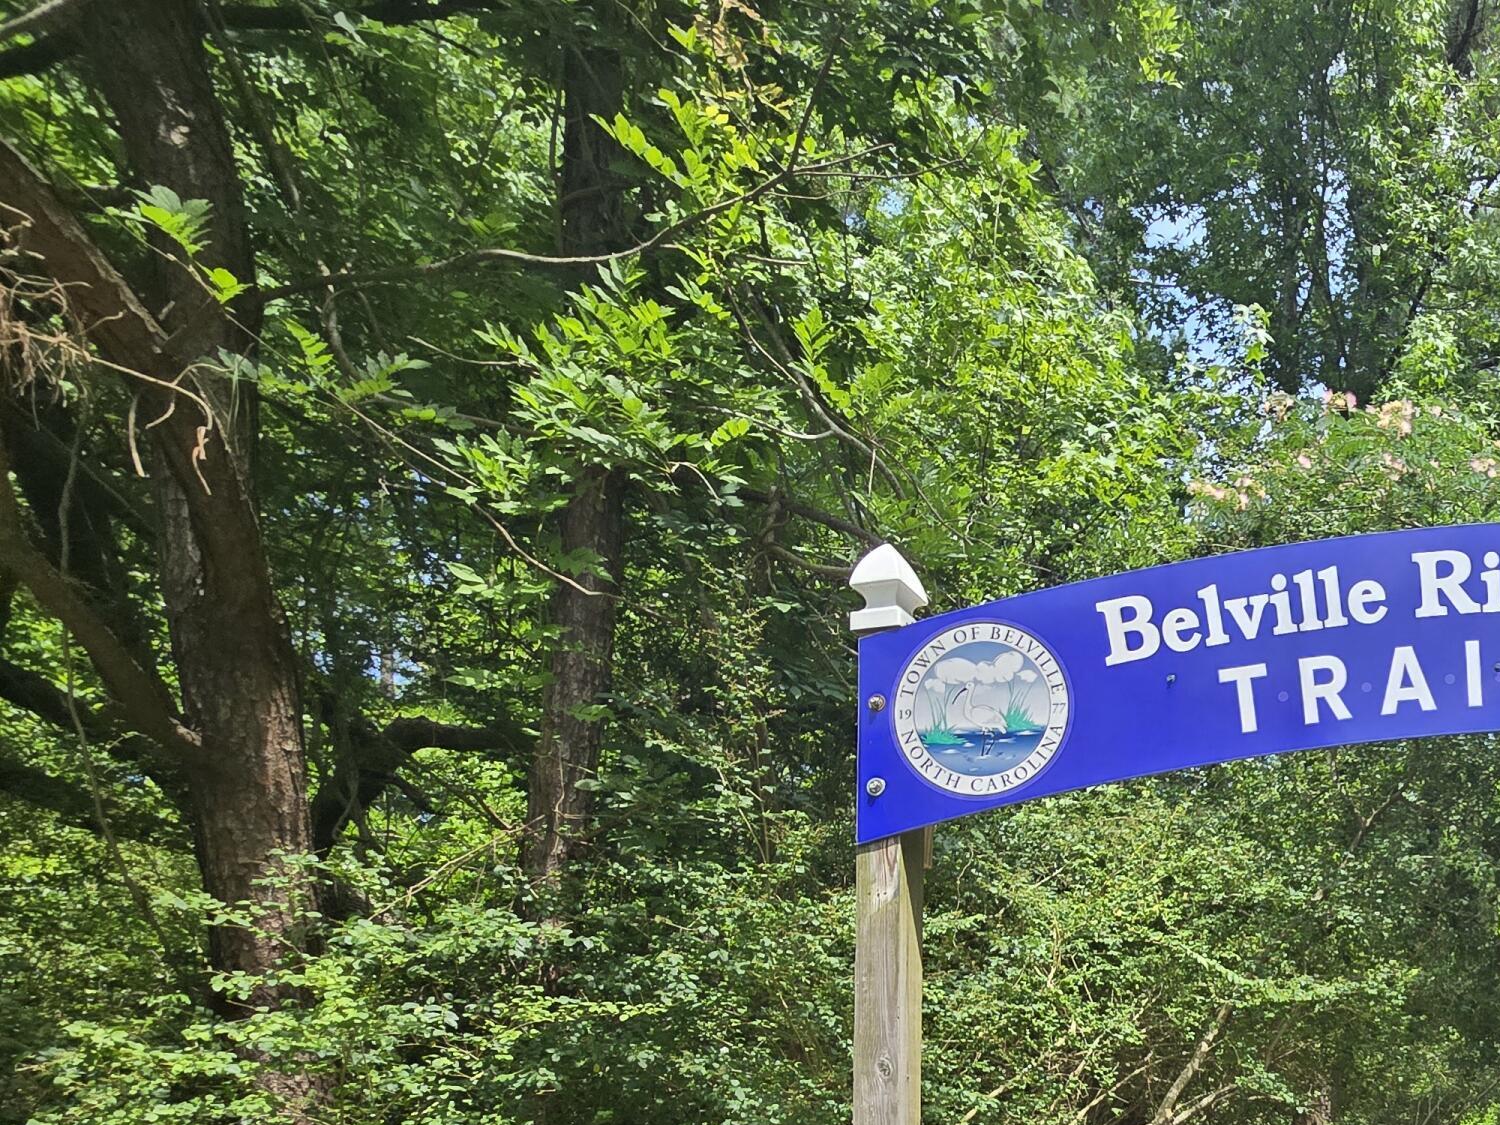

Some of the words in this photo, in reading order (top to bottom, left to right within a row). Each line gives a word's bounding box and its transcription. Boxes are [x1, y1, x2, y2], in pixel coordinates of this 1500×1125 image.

[1096, 565, 1388, 666] Belville
[900, 640, 946, 699] TOWN
[953, 627, 980, 644] OF
[990, 626, 1065, 695] BELVILLE
[899, 709, 912, 720] 19
[1052, 702, 1066, 715] 77
[901, 729, 961, 789] NORTH
[971, 725, 1063, 792] CAROLINA
